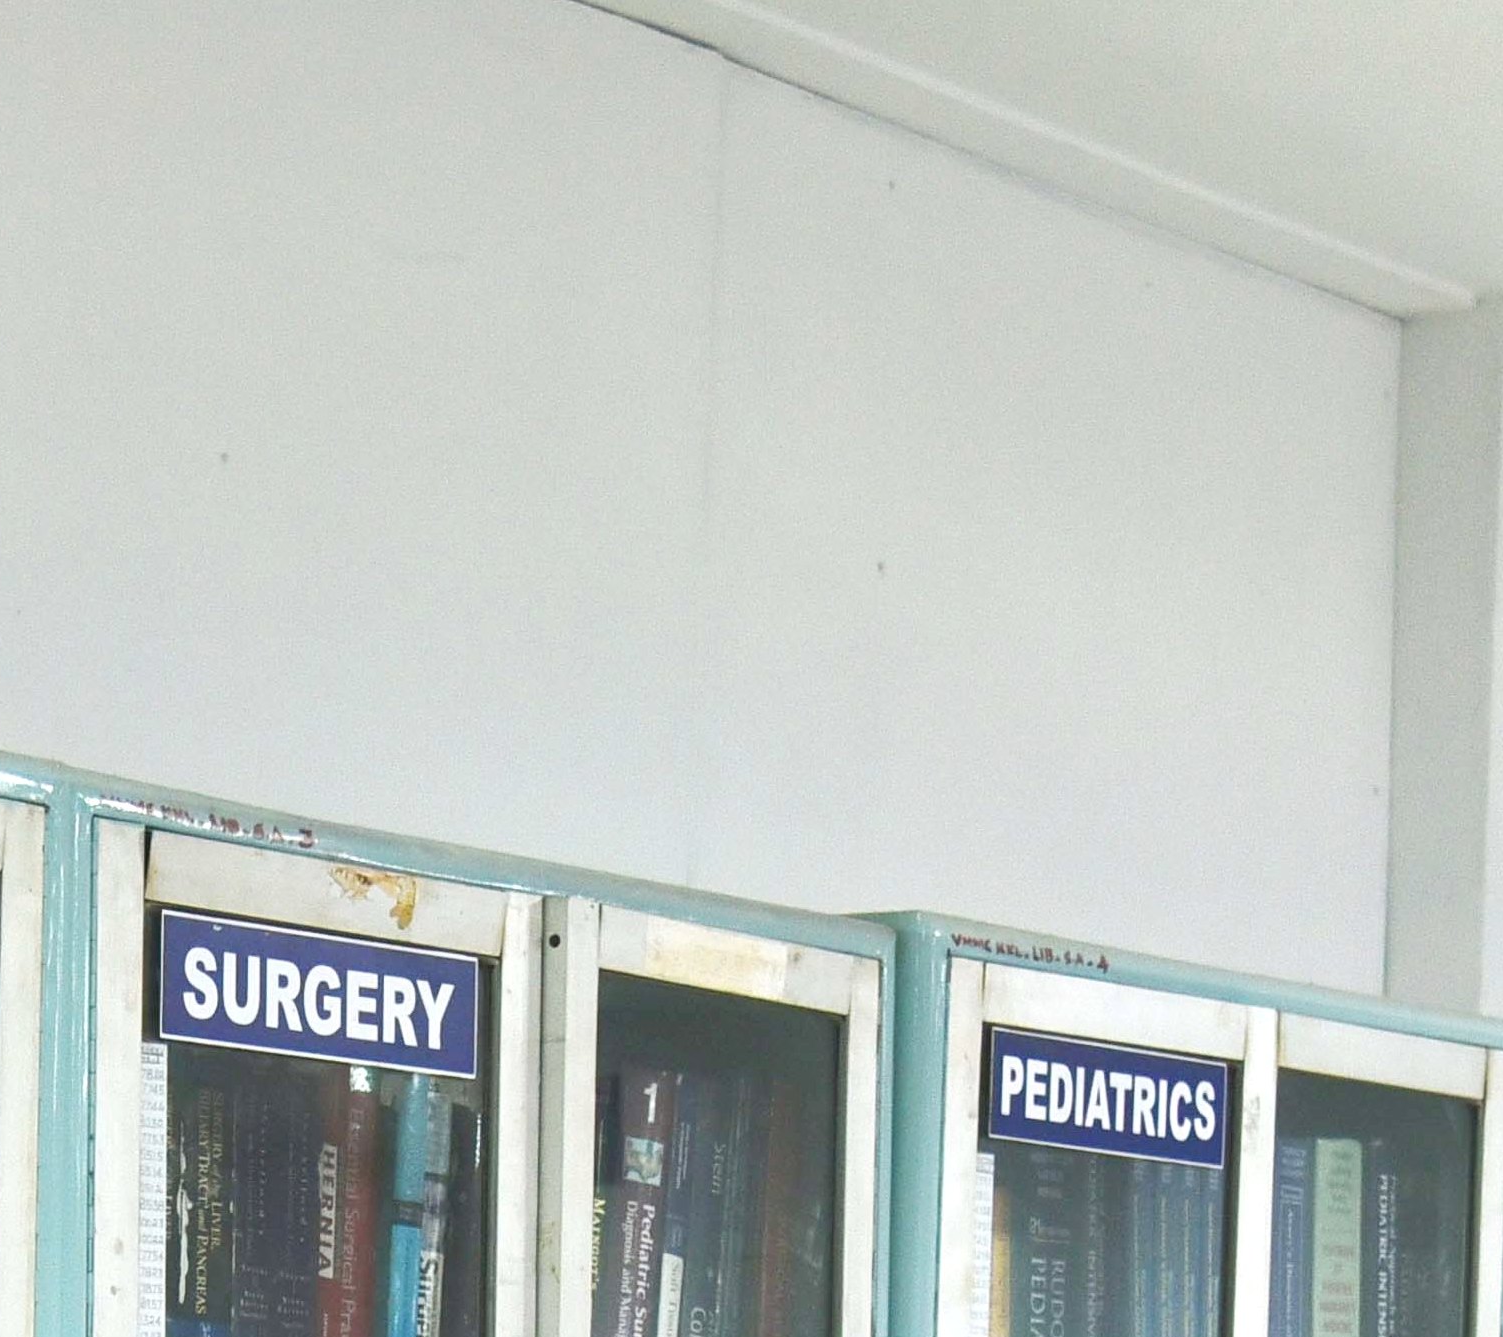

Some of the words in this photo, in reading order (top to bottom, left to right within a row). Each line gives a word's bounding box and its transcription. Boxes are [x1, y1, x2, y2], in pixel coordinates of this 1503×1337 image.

[182, 946, 455, 1051] SURGERY
[999, 1054, 1216, 1141] PEDIATRICS
[318, 1145, 337, 1281] HERNIA
